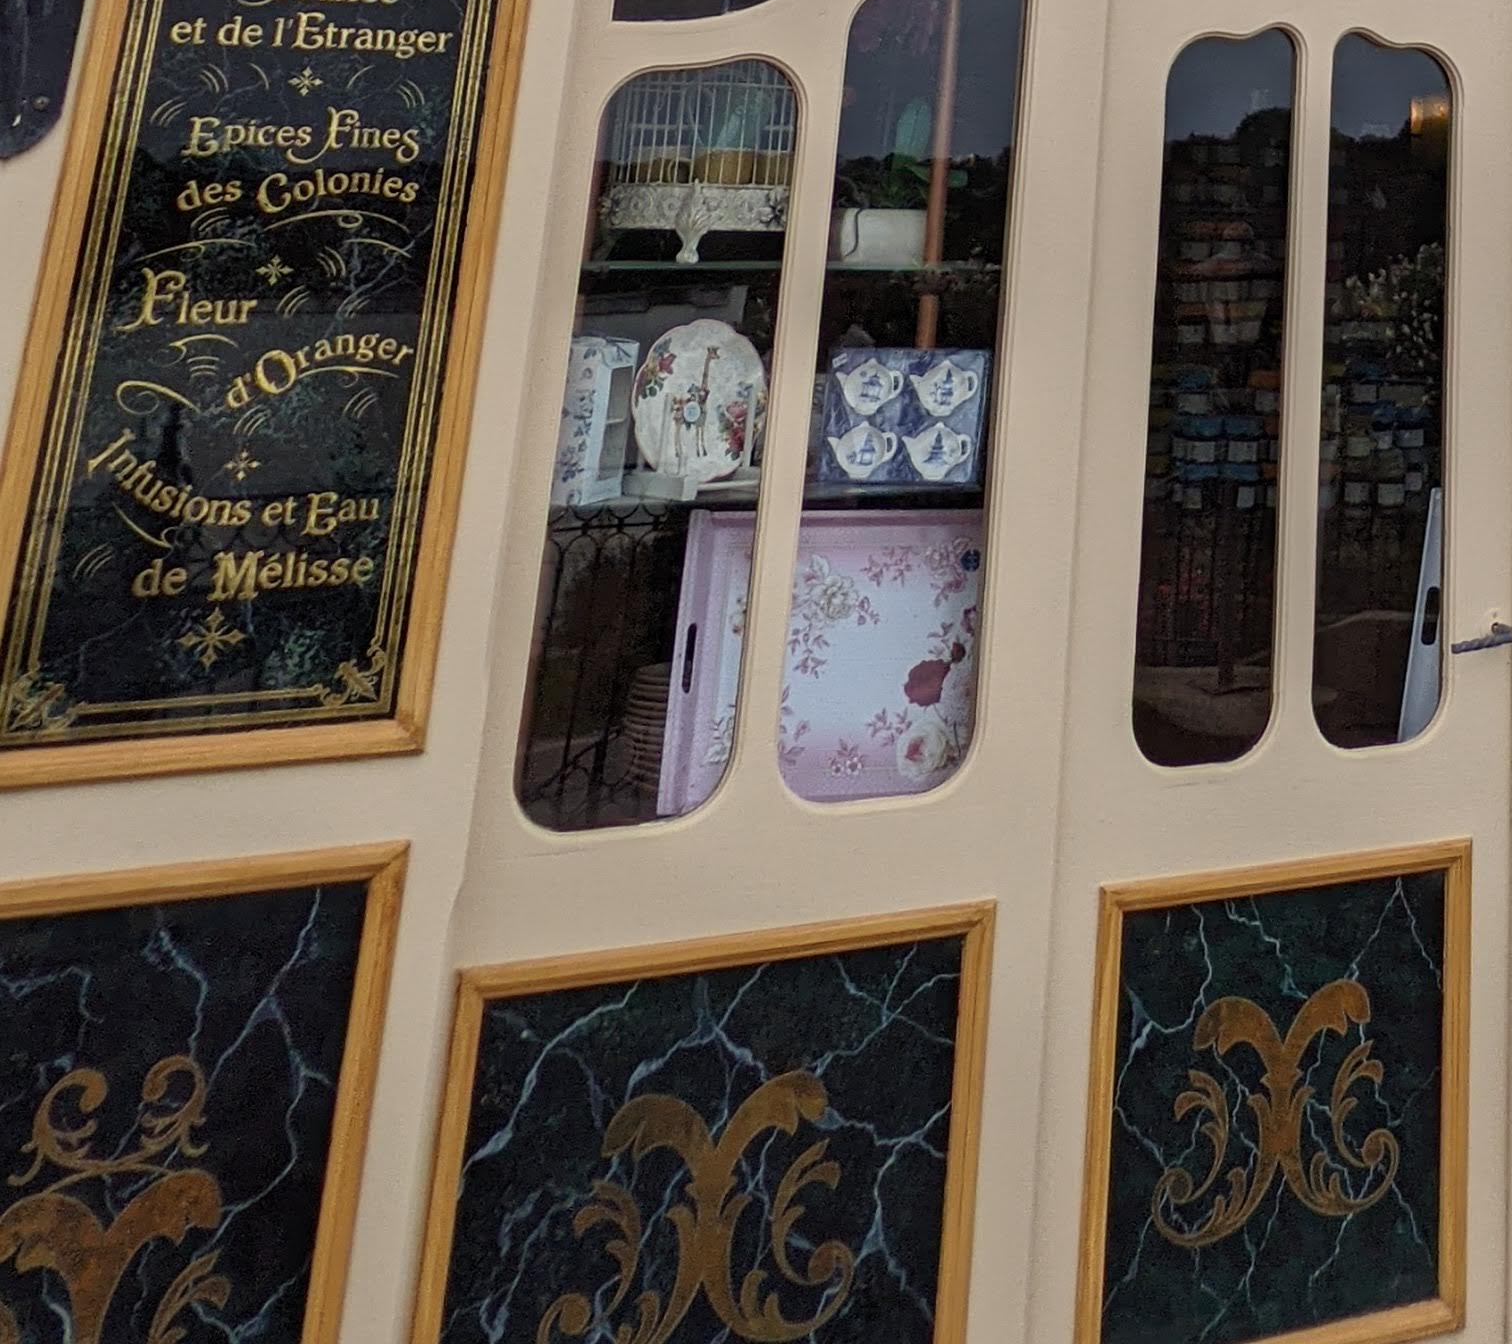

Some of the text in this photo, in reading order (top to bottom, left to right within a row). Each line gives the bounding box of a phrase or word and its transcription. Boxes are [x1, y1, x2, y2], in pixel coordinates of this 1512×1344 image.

[171, 12, 453, 59] et de l'Etranger
[181, 106, 420, 163] Epices Fines
[176, 167, 420, 213] des Colonies
[112, 267, 257, 332] Fleur
[225, 333, 414, 409] d'Oranger
[86, 428, 380, 536] Infusions et Eau
[132, 550, 374, 602] de Mélisse
